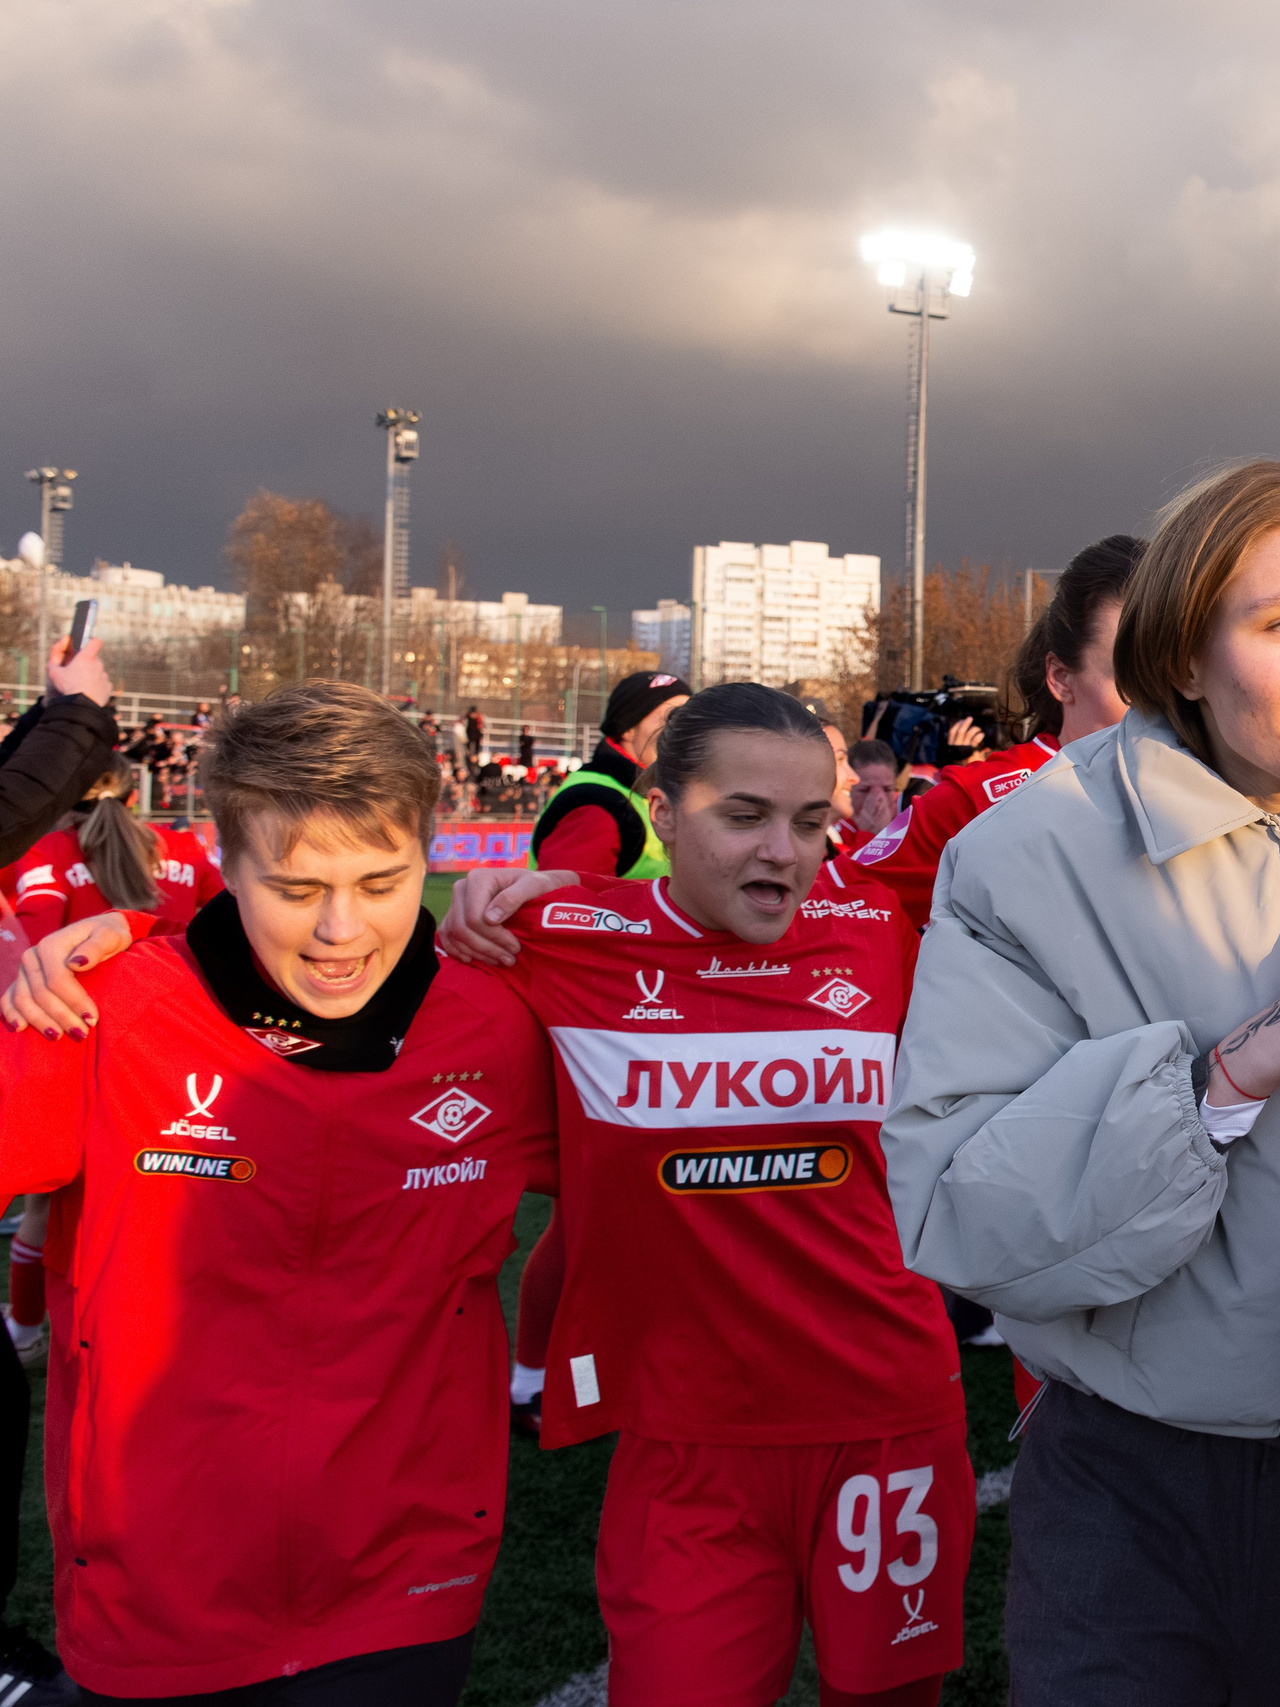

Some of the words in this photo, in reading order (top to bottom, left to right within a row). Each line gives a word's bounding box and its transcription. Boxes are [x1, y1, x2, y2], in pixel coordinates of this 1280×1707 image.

[428, 833, 533, 862] ОЗДР
[802, 908, 892, 922] ПРОТЕКТ
[622, 1005, 684, 1019] JÖGEL
[616, 1046, 884, 1109] ЛУКОЙЛ
[160, 1119, 237, 1141] JÖGEL
[143, 1153, 232, 1176] WINLINE
[402, 1156, 488, 1190] ЛУКОЙЛ
[675, 1152, 816, 1185] WINLINE
[837, 1465, 938, 1593] 93
[891, 1621, 939, 1645] JÖGEL
